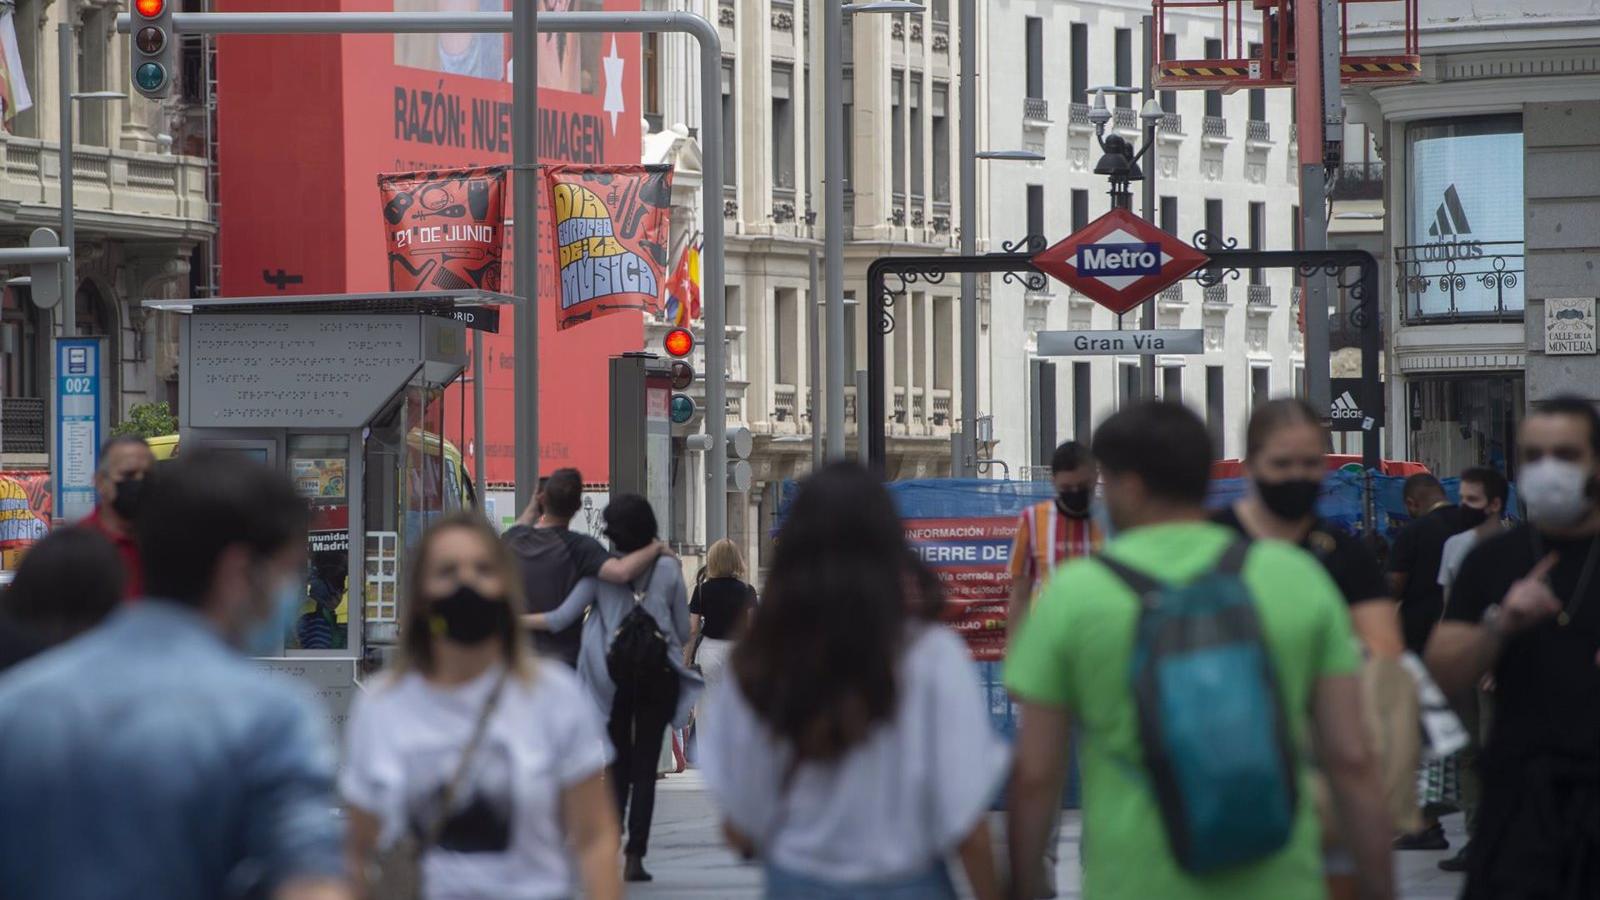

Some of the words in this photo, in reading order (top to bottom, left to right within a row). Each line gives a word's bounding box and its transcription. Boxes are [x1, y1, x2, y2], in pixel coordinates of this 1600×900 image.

[394, 80, 465, 148] RAZÓN:
[472, 98, 513, 154] NUE
[538, 108, 604, 164] IMAGEN
[396, 228, 411, 247] 21
[420, 227, 441, 243] DE
[446, 225, 492, 243] JUNIO
[1083, 249, 1156, 270] Metro
[1074, 336, 1124, 350] Gran
[1549, 333, 1574, 341] CALLE
[1548, 342, 1593, 351] MONTERA
[66, 378, 91, 393] 002
[1331, 409, 1363, 418] didas
[308, 532, 348, 542] munida
[905, 526, 984, 538] INFORMACIÓN
[909, 546, 977, 562] IERRE
[982, 545, 1008, 560] DE
